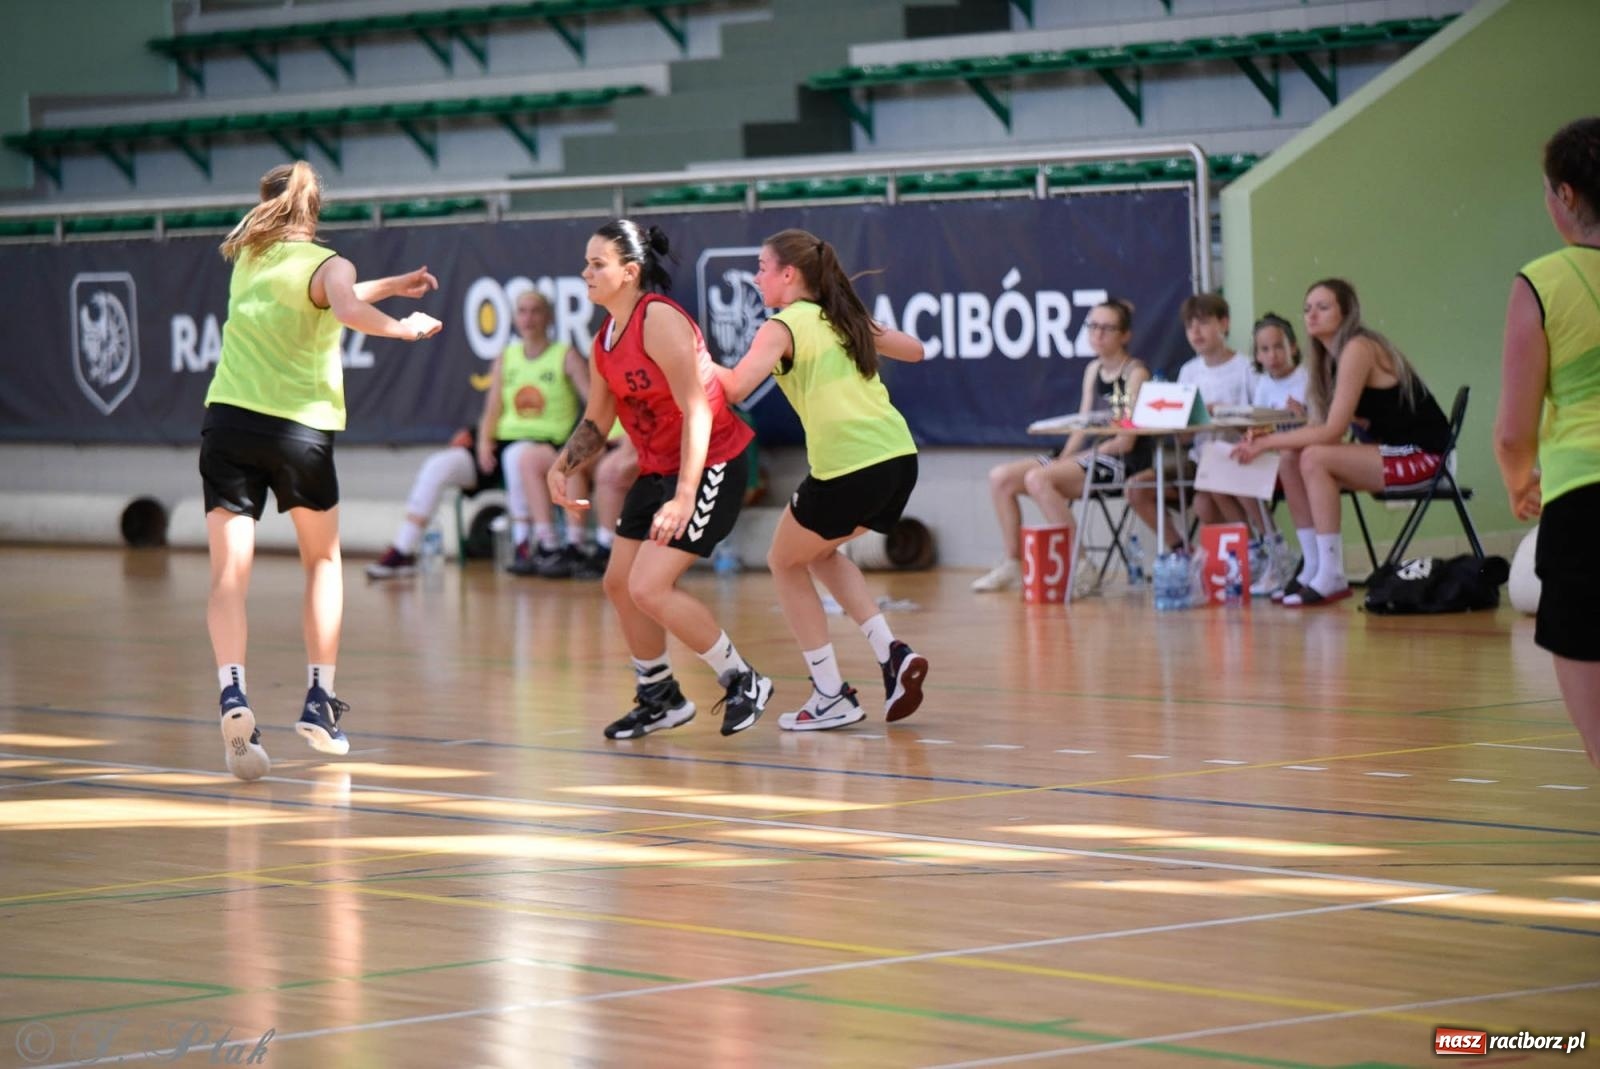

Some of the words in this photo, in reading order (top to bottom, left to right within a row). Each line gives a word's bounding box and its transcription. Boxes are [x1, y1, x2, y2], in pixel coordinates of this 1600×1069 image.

[873, 266, 1107, 360] ACIBÓRZ
[625, 368, 651, 392] 53
[1023, 534, 1036, 585] 5
[1043, 533, 1065, 585] 5
[1211, 533, 1241, 584] 5
